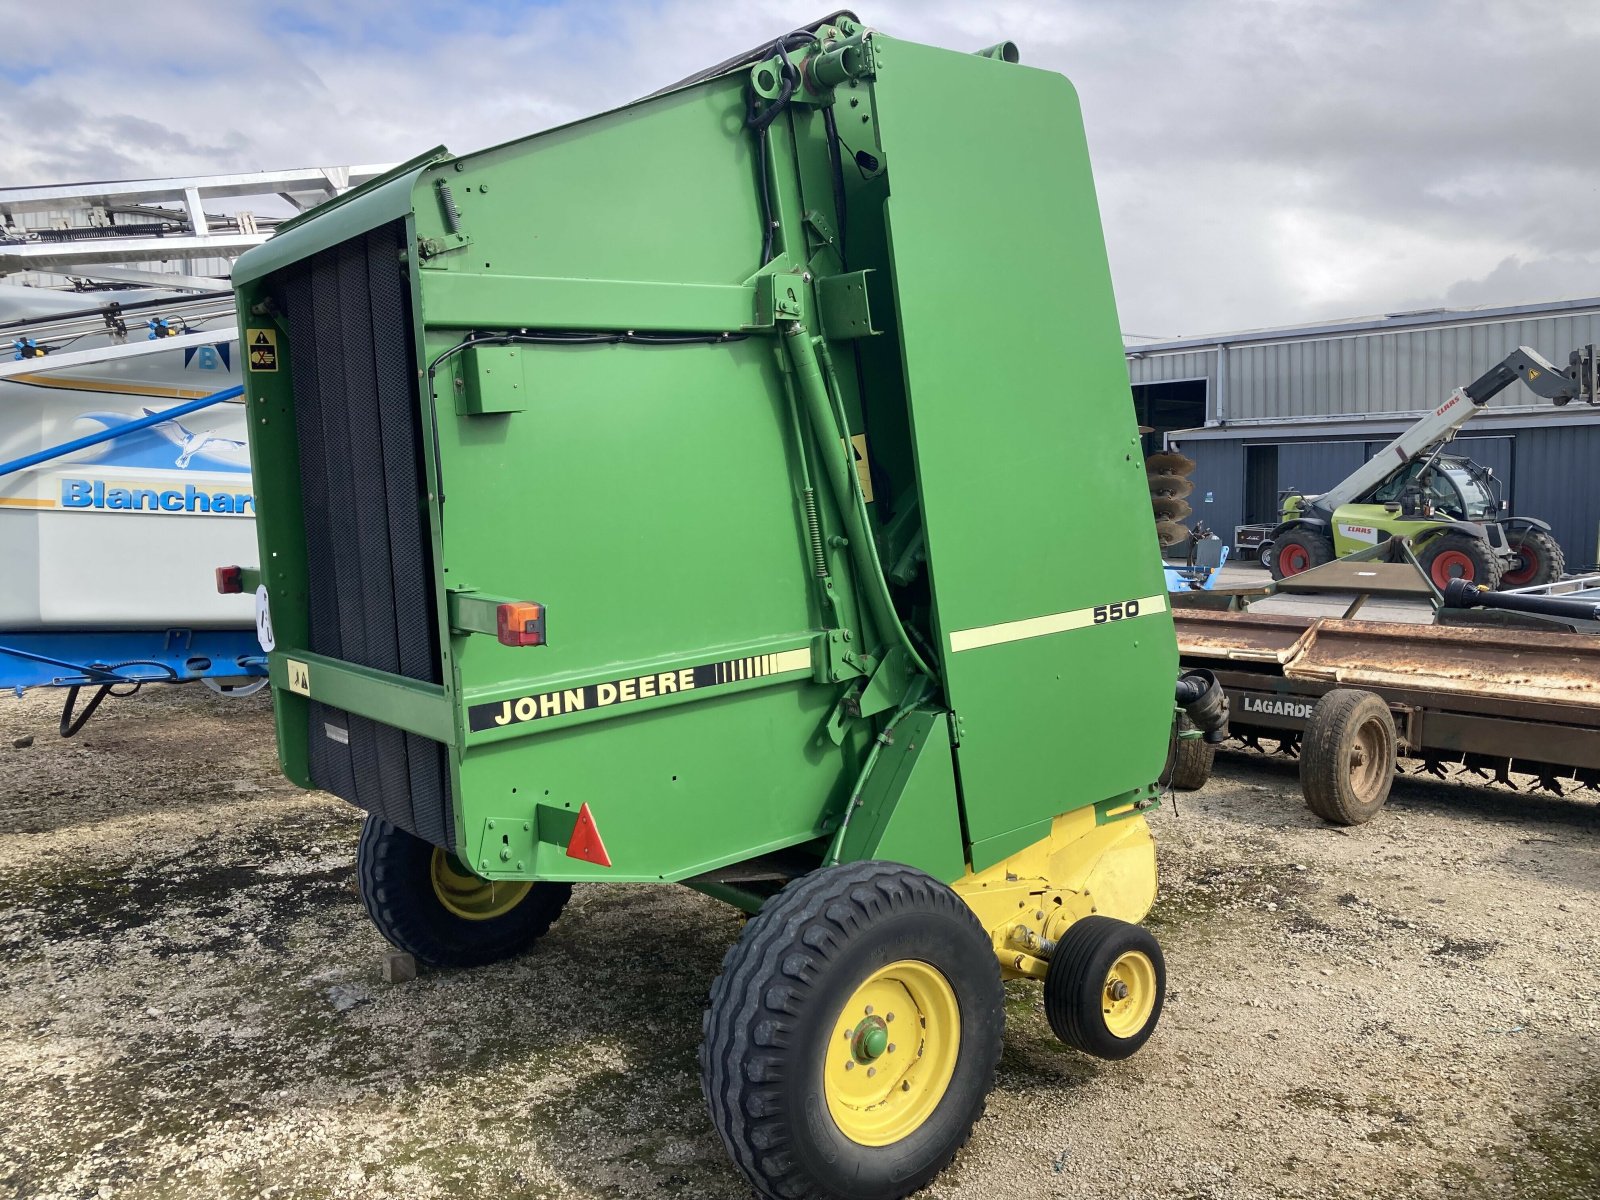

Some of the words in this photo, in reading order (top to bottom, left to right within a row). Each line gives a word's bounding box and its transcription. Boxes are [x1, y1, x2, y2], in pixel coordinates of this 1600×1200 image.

[1436, 395, 1461, 416] CLAAS
[61, 479, 256, 513] Blanchar
[1347, 526, 1372, 534] CLAAS
[1093, 600, 1140, 624] 550
[494, 687, 585, 726] JOHN
[596, 668, 695, 707] DEERE
[1244, 698, 1313, 719] LAGARDE
